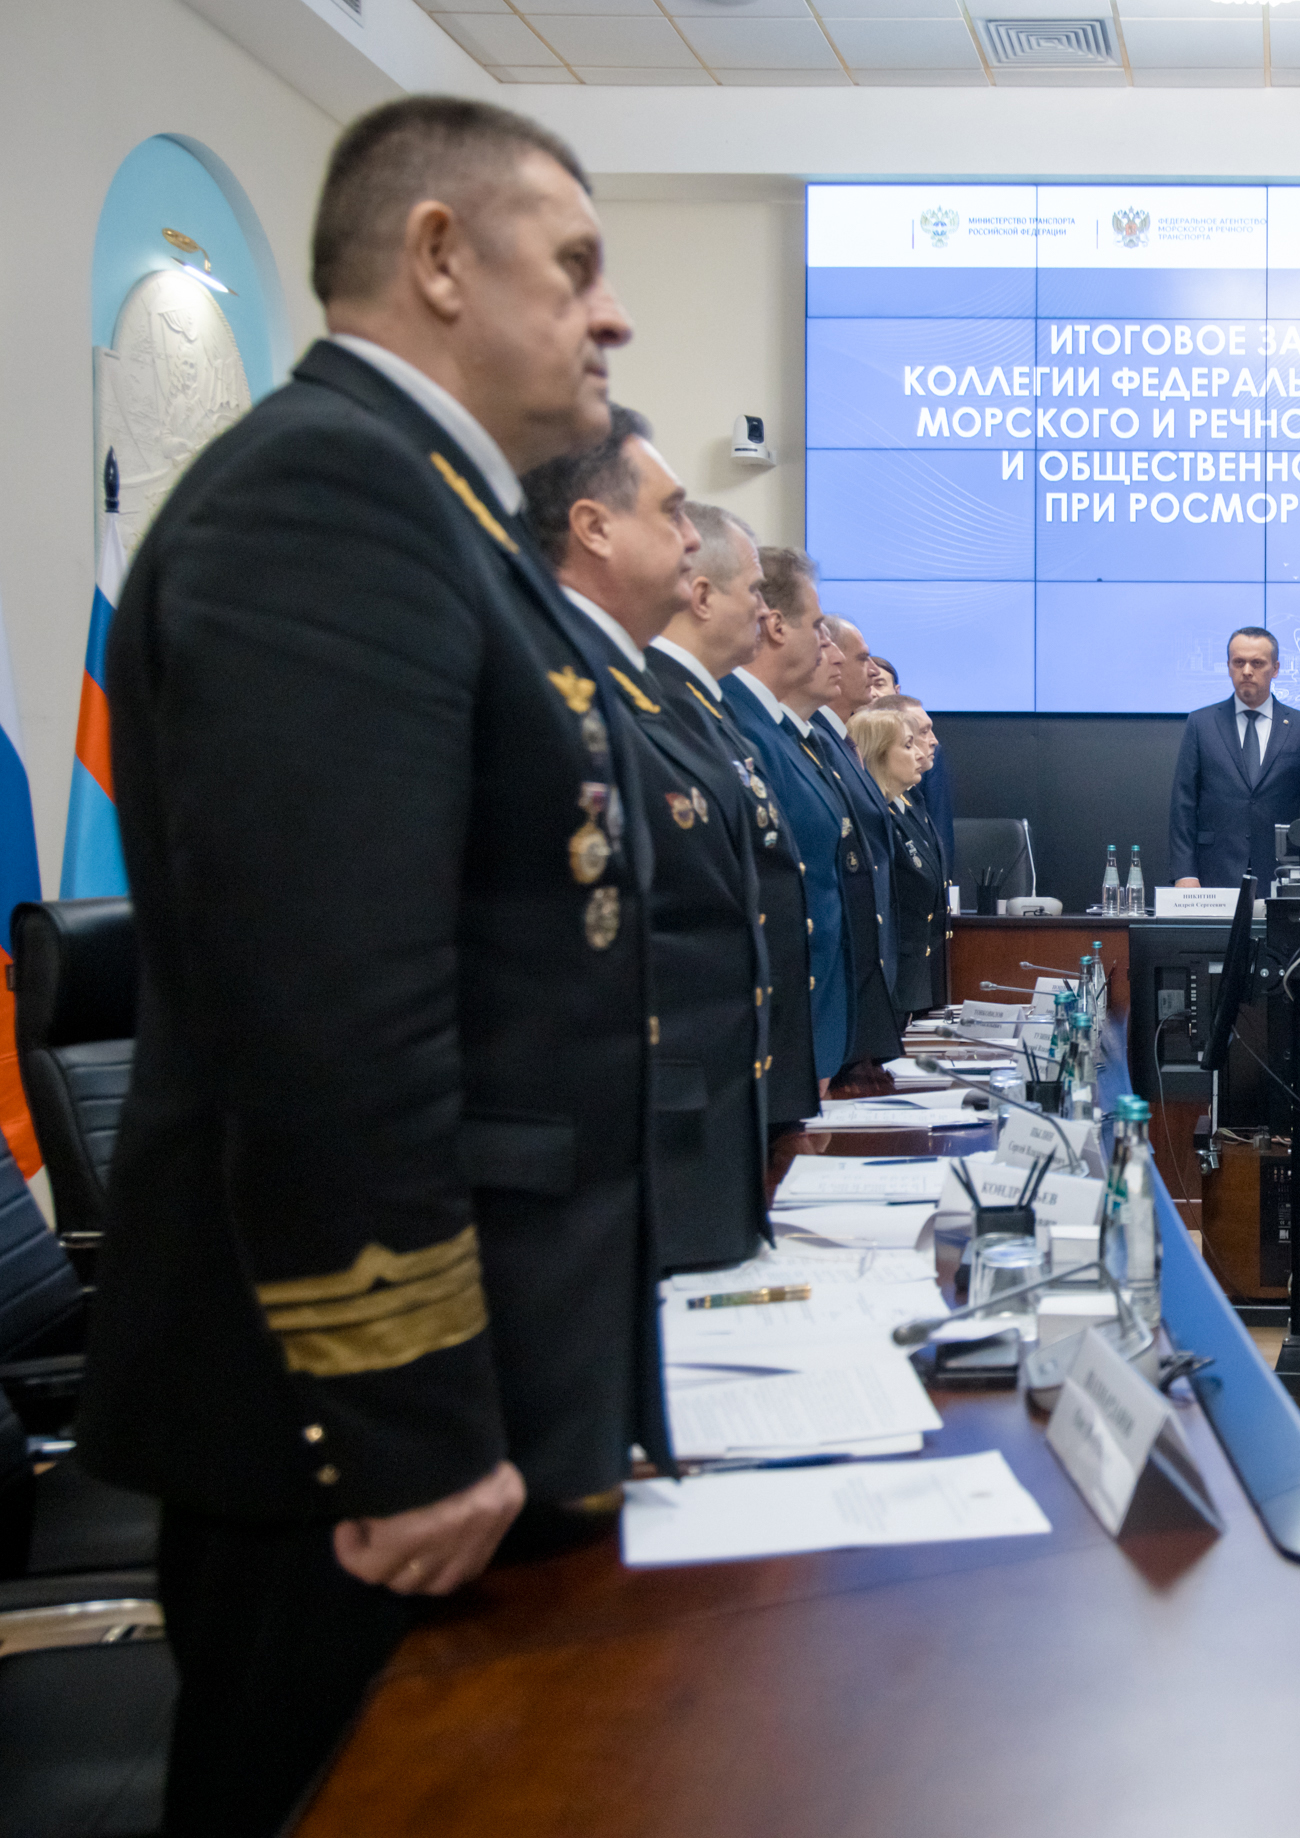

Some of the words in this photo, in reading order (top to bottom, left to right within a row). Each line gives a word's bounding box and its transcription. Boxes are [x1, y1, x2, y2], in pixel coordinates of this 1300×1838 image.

[968, 217, 1027, 225] МИНИСТЕРСТВО
[1029, 217, 1076, 225] ТРАНСПОРТА
[968, 227, 1019, 236] РОССИЙСКОЙ
[1020, 228, 1067, 237] ФЕДЕРАЦИИ
[1158, 218, 1217, 226] ФЕДЕРАЛЬНОЕ
[1050, 324, 1246, 356] ИТОГОВОЕ
[904, 365, 1100, 397] КОЛЛЕГИИ
[916, 406, 1140, 439] МОРСКОГО
[1153, 408, 1175, 438] И
[1002, 450, 1024, 480] И
[1045, 492, 1115, 522] ПРИ
